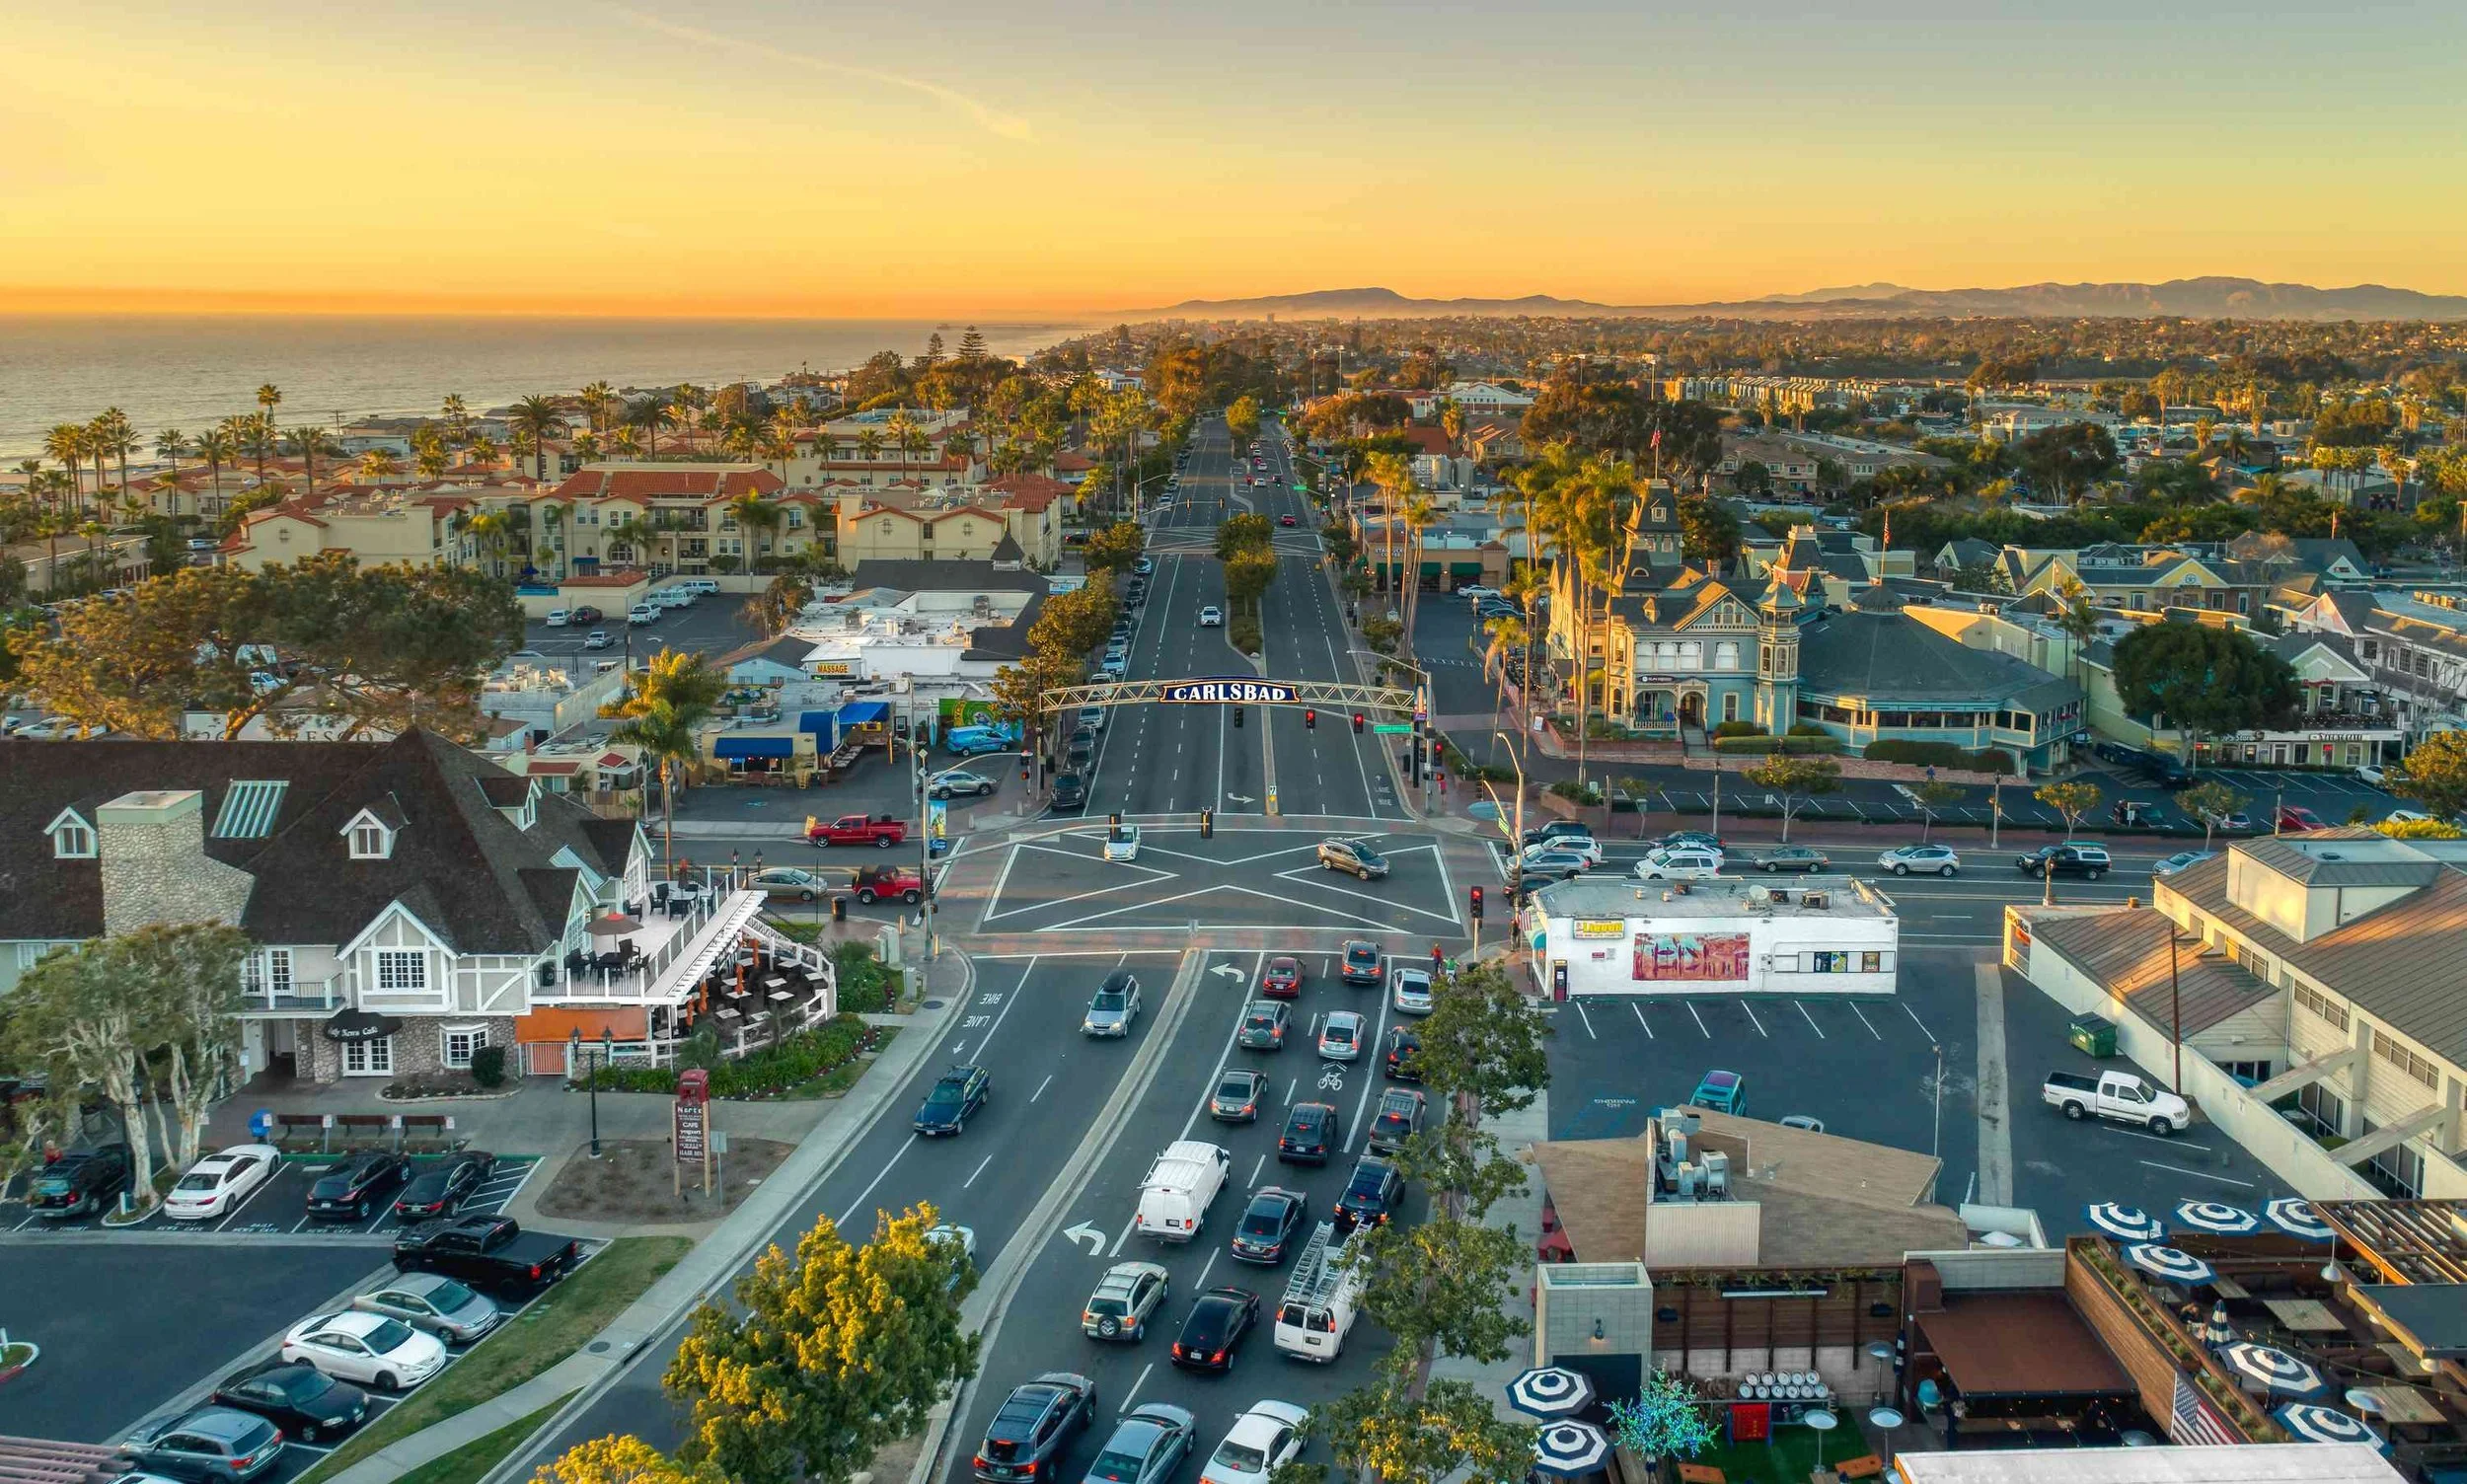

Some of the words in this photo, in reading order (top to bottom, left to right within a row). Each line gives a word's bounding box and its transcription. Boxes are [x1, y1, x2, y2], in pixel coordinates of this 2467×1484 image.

[817, 664, 849, 674] MASSAGE
[1173, 683, 1287, 701] CARLSBAD
[979, 993, 1004, 1004] BIKE
[962, 1015, 991, 1027] LANE
